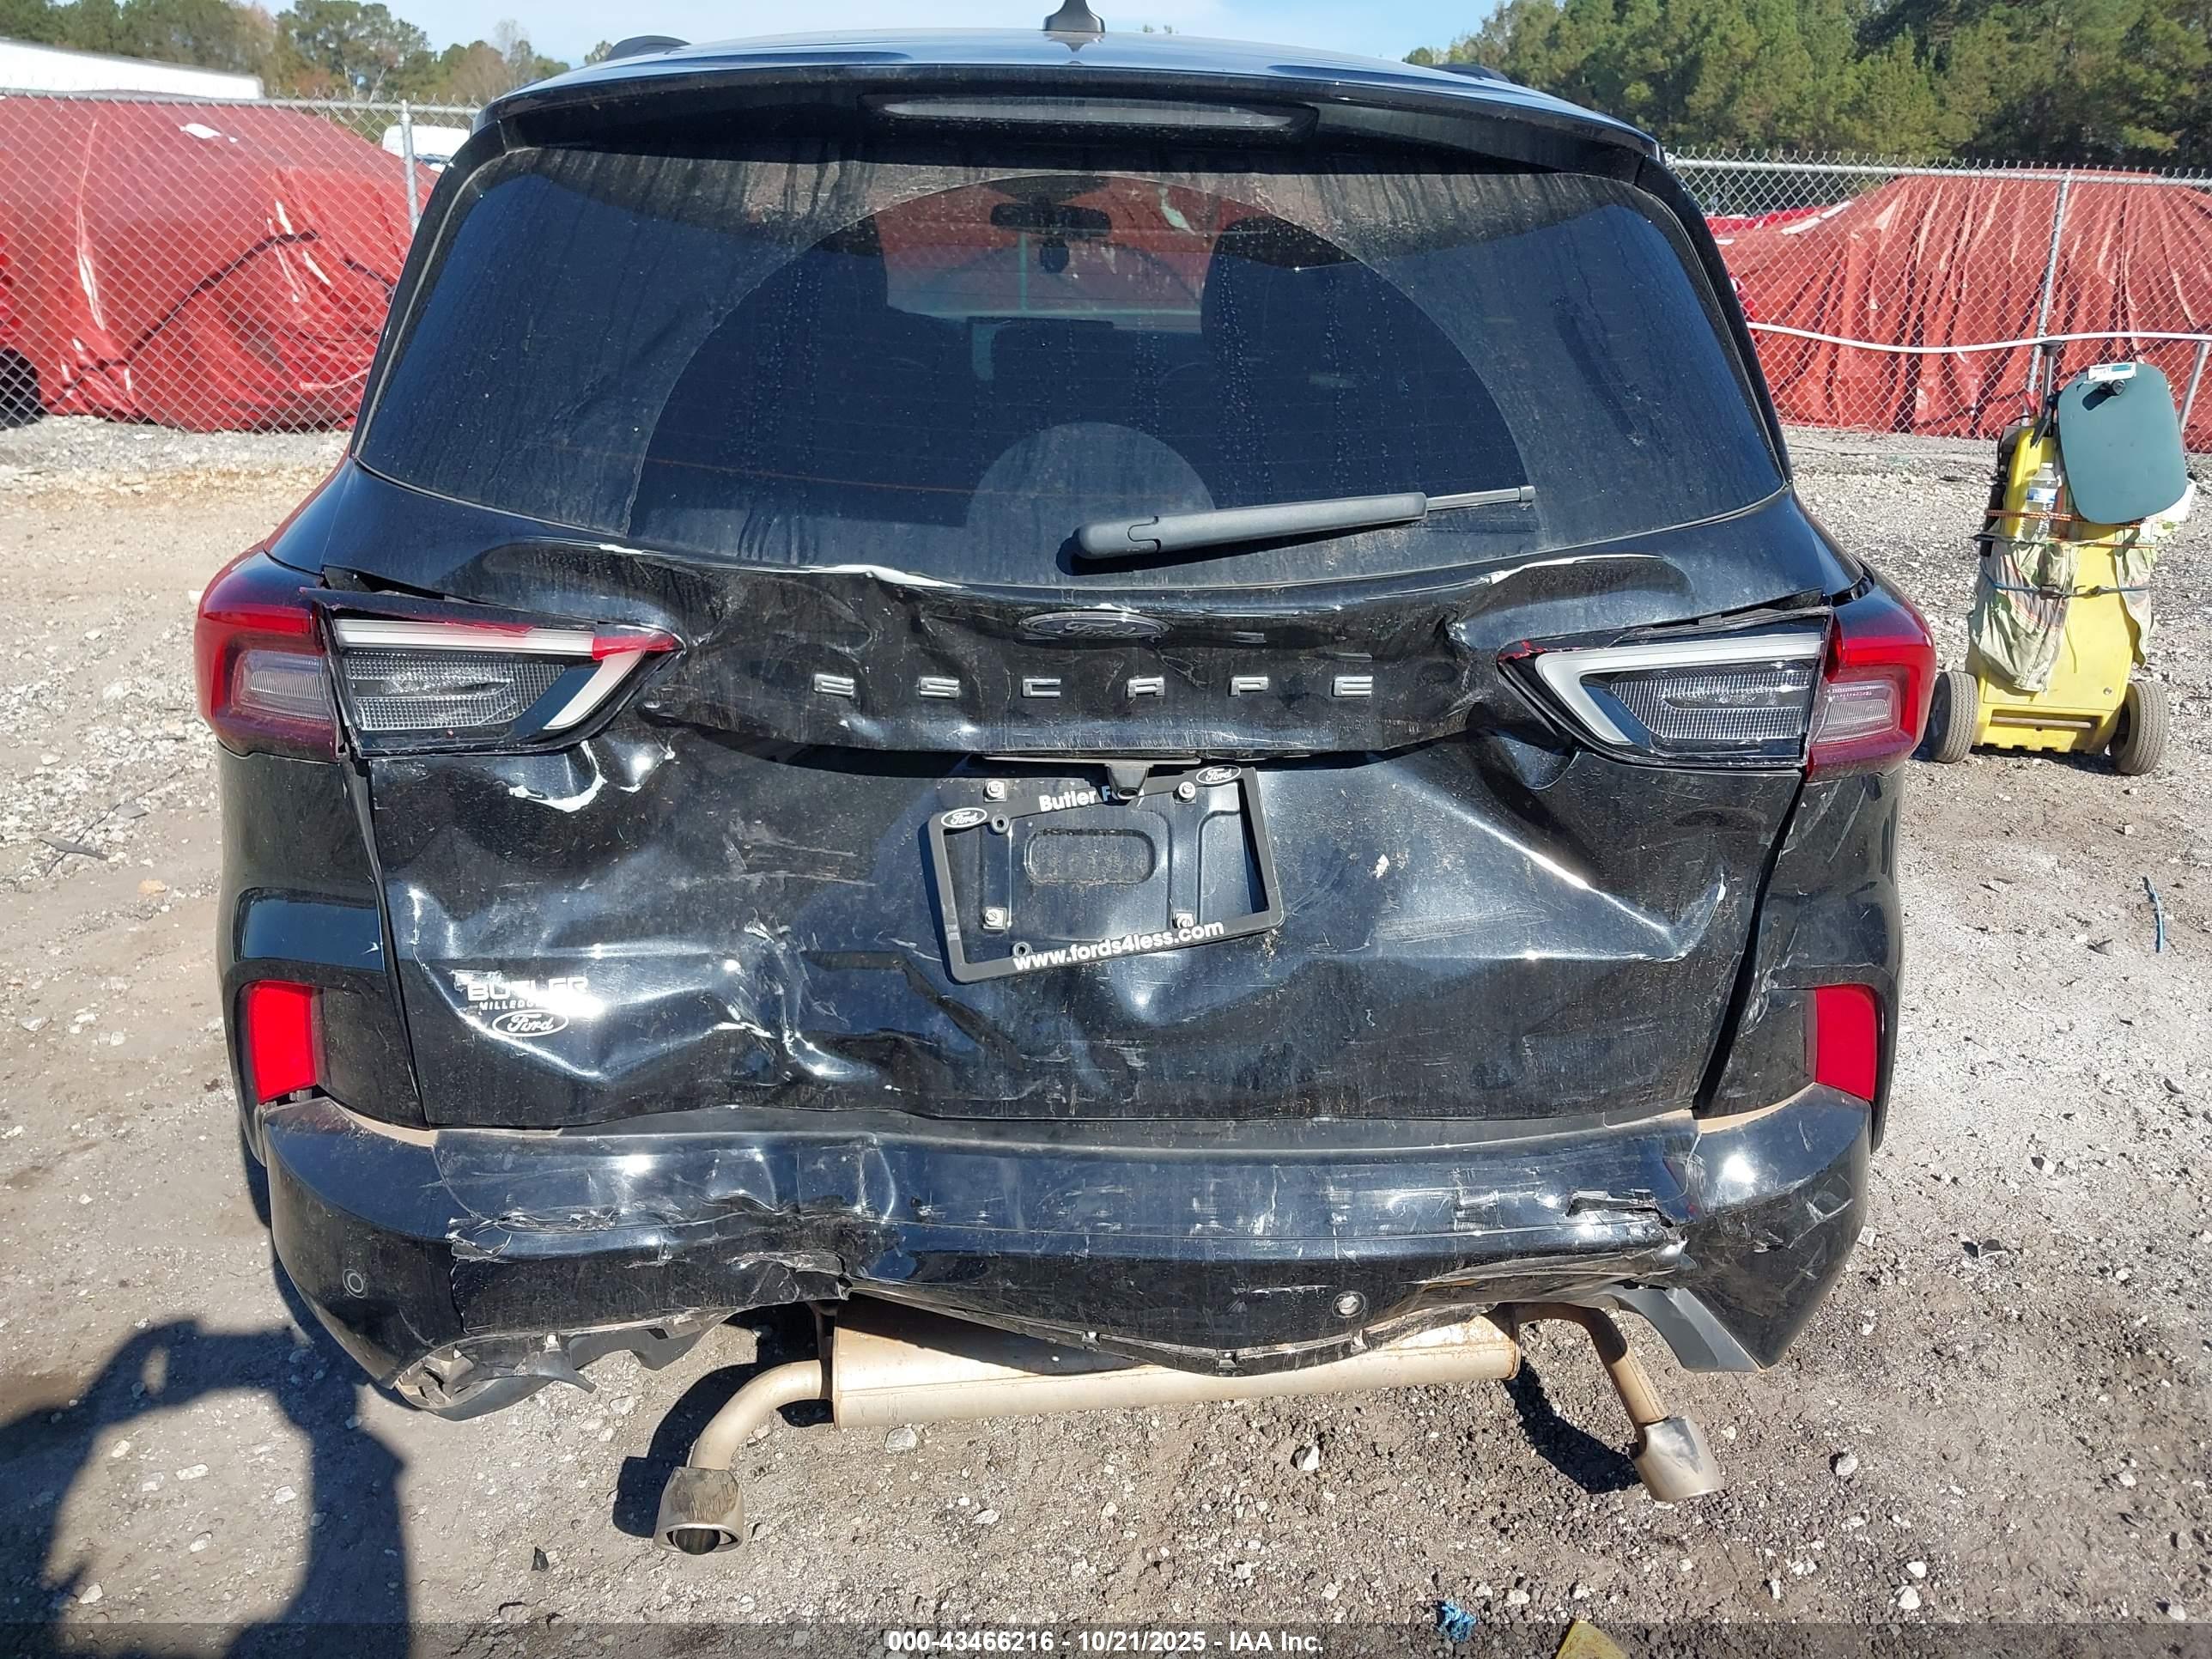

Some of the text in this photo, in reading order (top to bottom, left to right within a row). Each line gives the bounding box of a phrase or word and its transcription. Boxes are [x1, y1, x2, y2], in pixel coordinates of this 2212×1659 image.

[1057, 621, 1139, 638] Ford
[813, 674, 1373, 698] ESCAPE
[1039, 789, 1097, 812] Butler
[1013, 921, 1224, 970] www.fords4less.com
[507, 1012, 555, 1032] Ford
